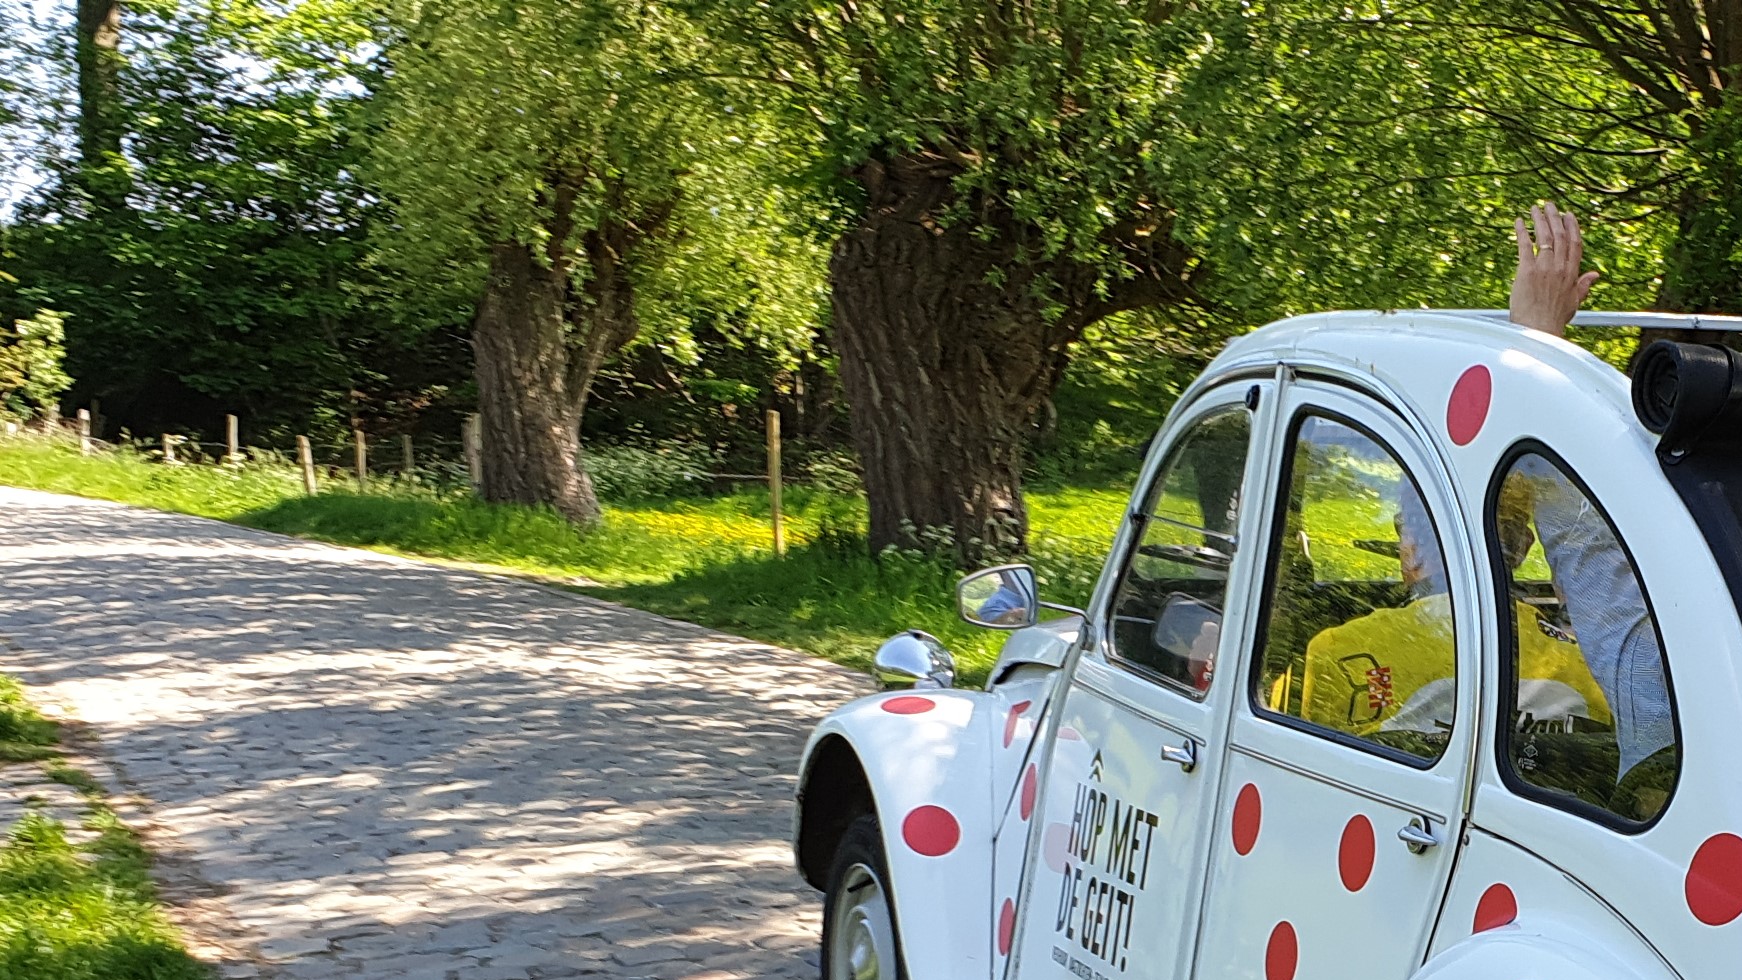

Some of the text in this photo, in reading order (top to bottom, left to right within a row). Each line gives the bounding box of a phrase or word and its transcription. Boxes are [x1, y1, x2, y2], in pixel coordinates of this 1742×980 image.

[1107, 799, 1159, 890] MET
[1055, 862, 1135, 972] DE GEIT!
